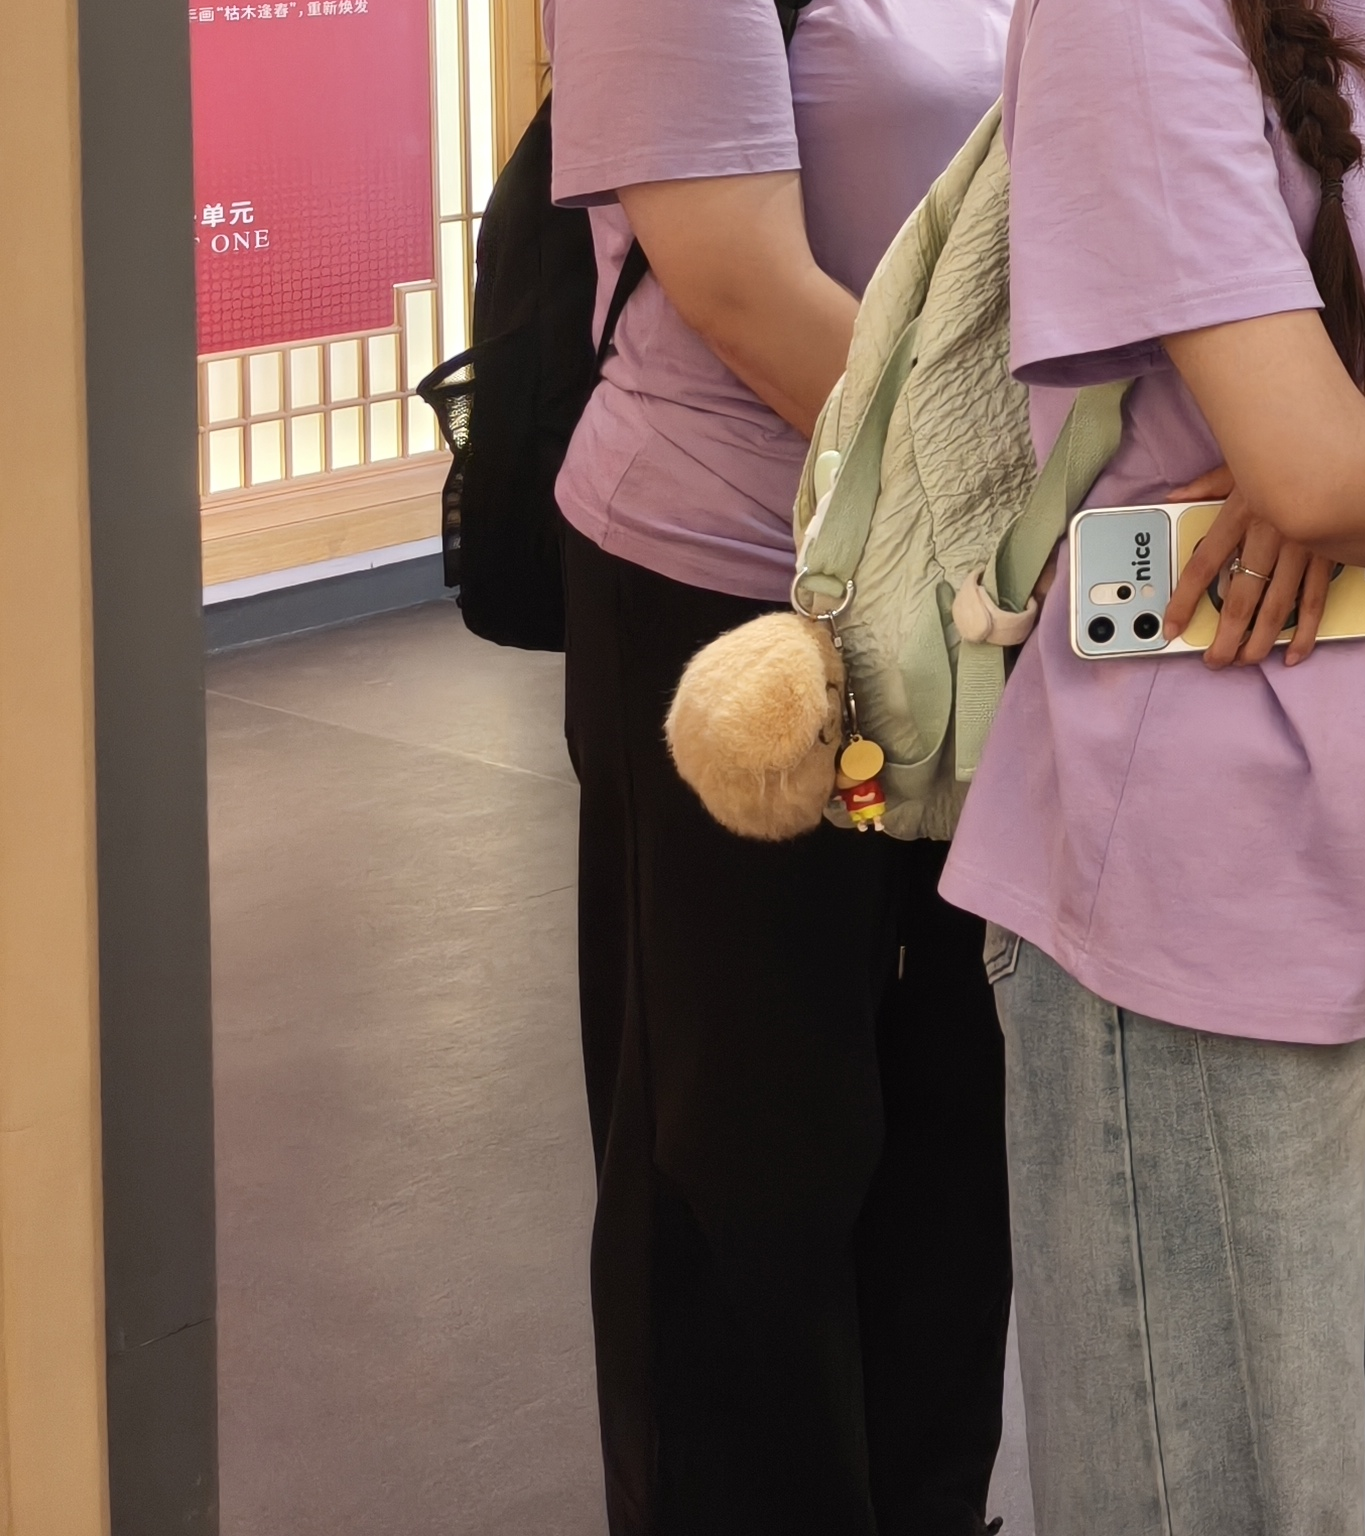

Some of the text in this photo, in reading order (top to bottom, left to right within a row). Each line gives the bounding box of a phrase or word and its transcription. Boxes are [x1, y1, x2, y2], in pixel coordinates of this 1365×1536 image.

[201, 201, 254, 228] 单元
[211, 230, 270, 253] ONE
[1131, 531, 1151, 582] nice
